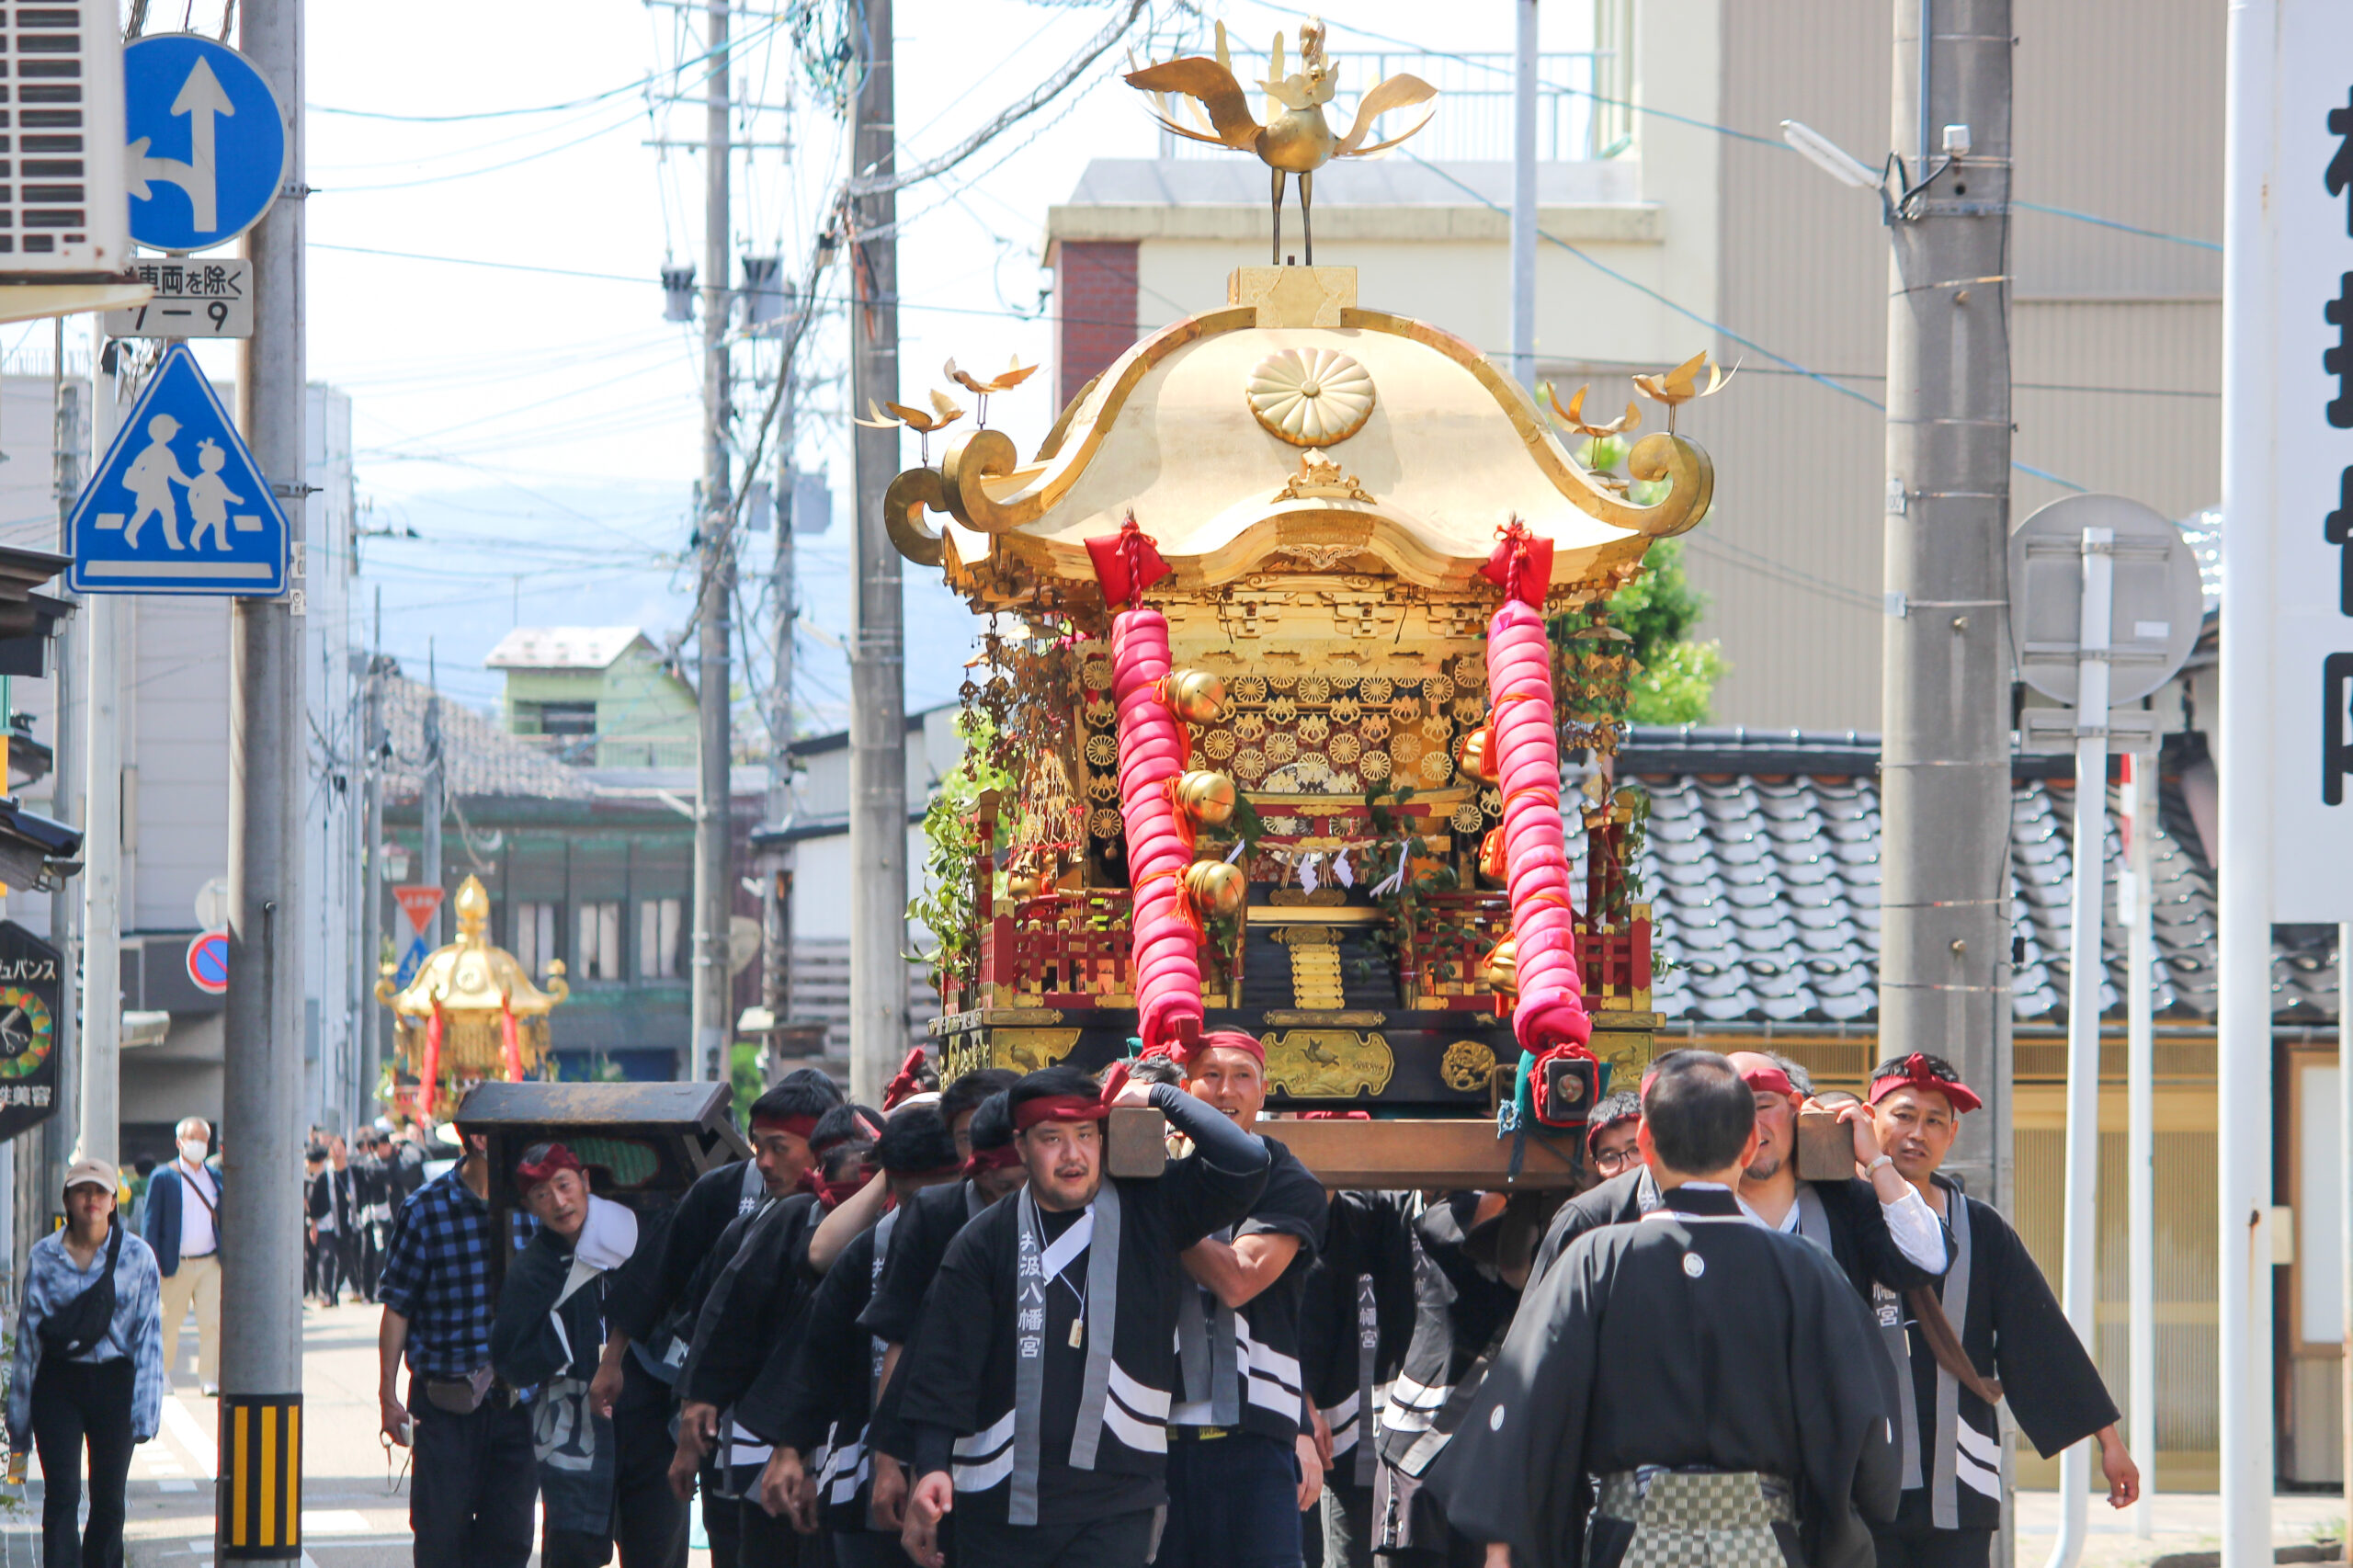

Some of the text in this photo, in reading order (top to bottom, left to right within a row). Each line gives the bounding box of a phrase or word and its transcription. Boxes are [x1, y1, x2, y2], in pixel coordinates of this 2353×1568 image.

[125, 265, 243, 295] 車両を除く
[0, 959, 56, 980] ュバンス
[1018, 1230, 1044, 1358] 井波八幡宮
